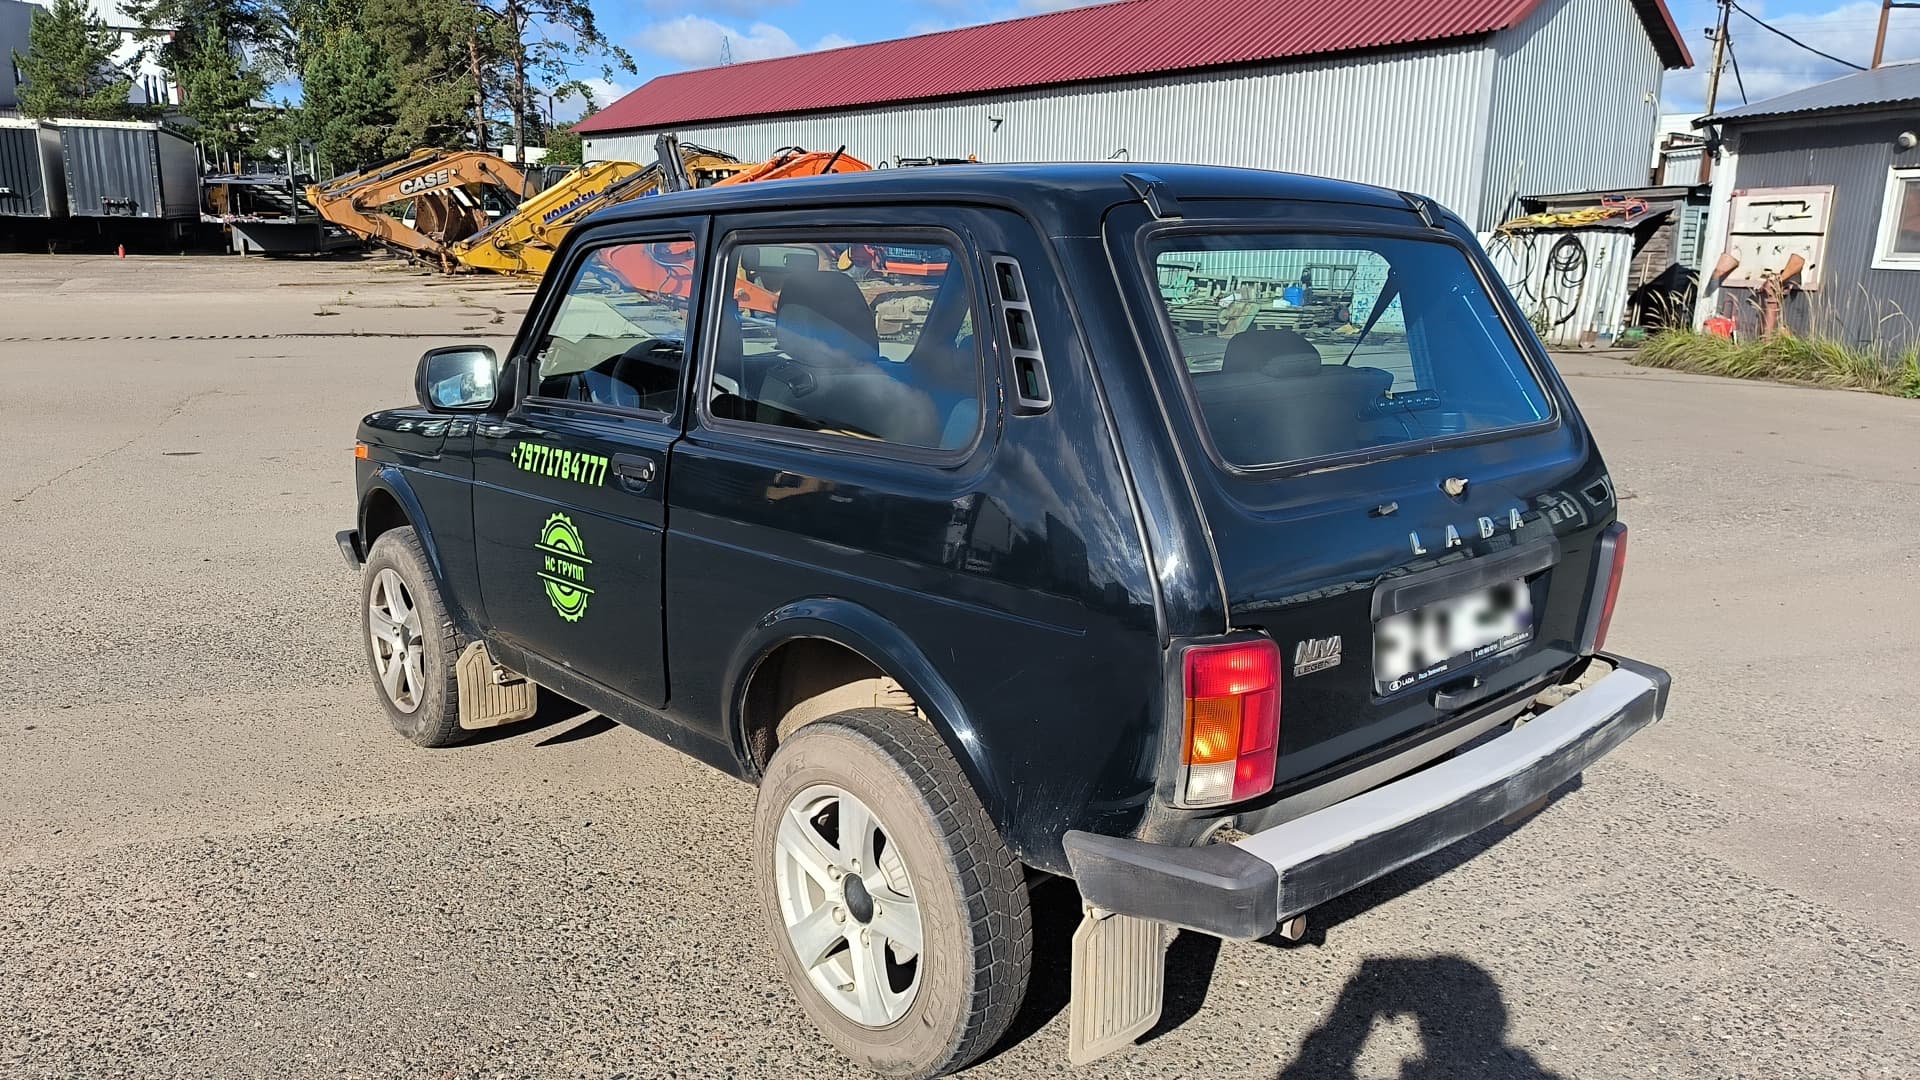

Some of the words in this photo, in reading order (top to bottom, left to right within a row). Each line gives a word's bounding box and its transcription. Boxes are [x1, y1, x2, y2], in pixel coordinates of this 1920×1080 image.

[400, 168, 449, 195] CASE
[511, 441, 608, 487] +79771784777
[1408, 508, 1525, 556] LADA
[557, 559, 585, 582] ГРУПП
[1295, 635, 1341, 665] NIVA
